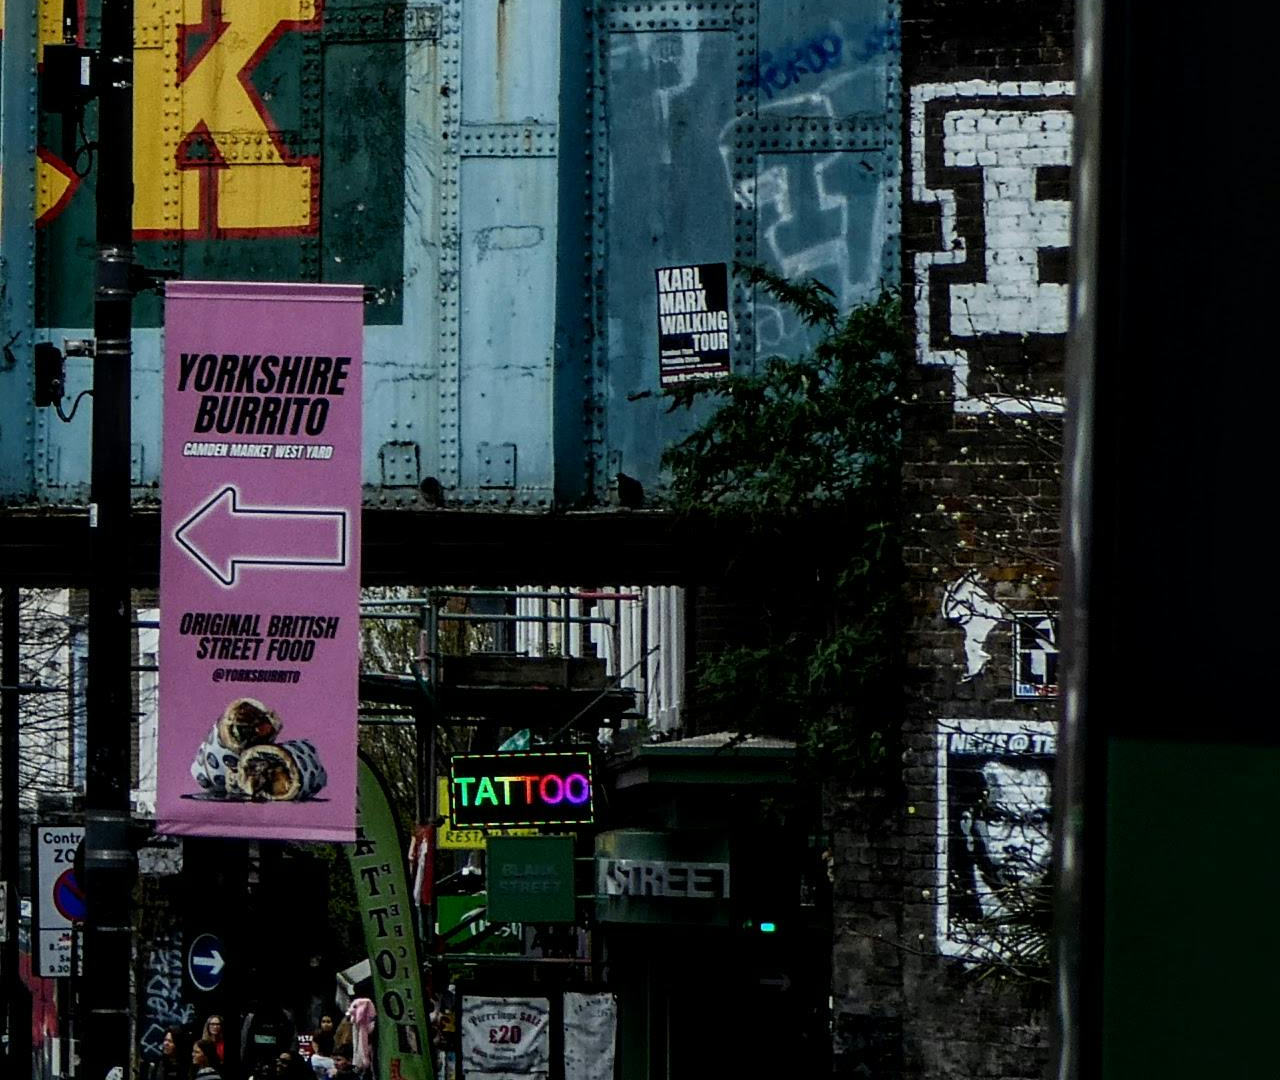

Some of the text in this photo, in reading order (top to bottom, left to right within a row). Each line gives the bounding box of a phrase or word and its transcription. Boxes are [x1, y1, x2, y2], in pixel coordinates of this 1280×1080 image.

[658, 267, 703, 292] KARL
[659, 289, 708, 314] MARX
[660, 311, 728, 335] WALKING
[692, 332, 729, 352] TOUR
[176, 353, 352, 395] YORKSHIRE
[194, 394, 330, 436] BURRITO
[183, 441, 334, 460] CAMDEN MARKET WEST YARD
[179, 613, 339, 638] ORIGINAL BRITISH
[196, 637, 316, 662] STREET FOOD
[212, 668, 301, 683] @YORKSBURRITO
[452, 773, 590, 807] TATTOO
[54, 849, 76, 863] ZO
[498, 880, 562, 893] STREET
[489, 1025, 521, 1044] £20
